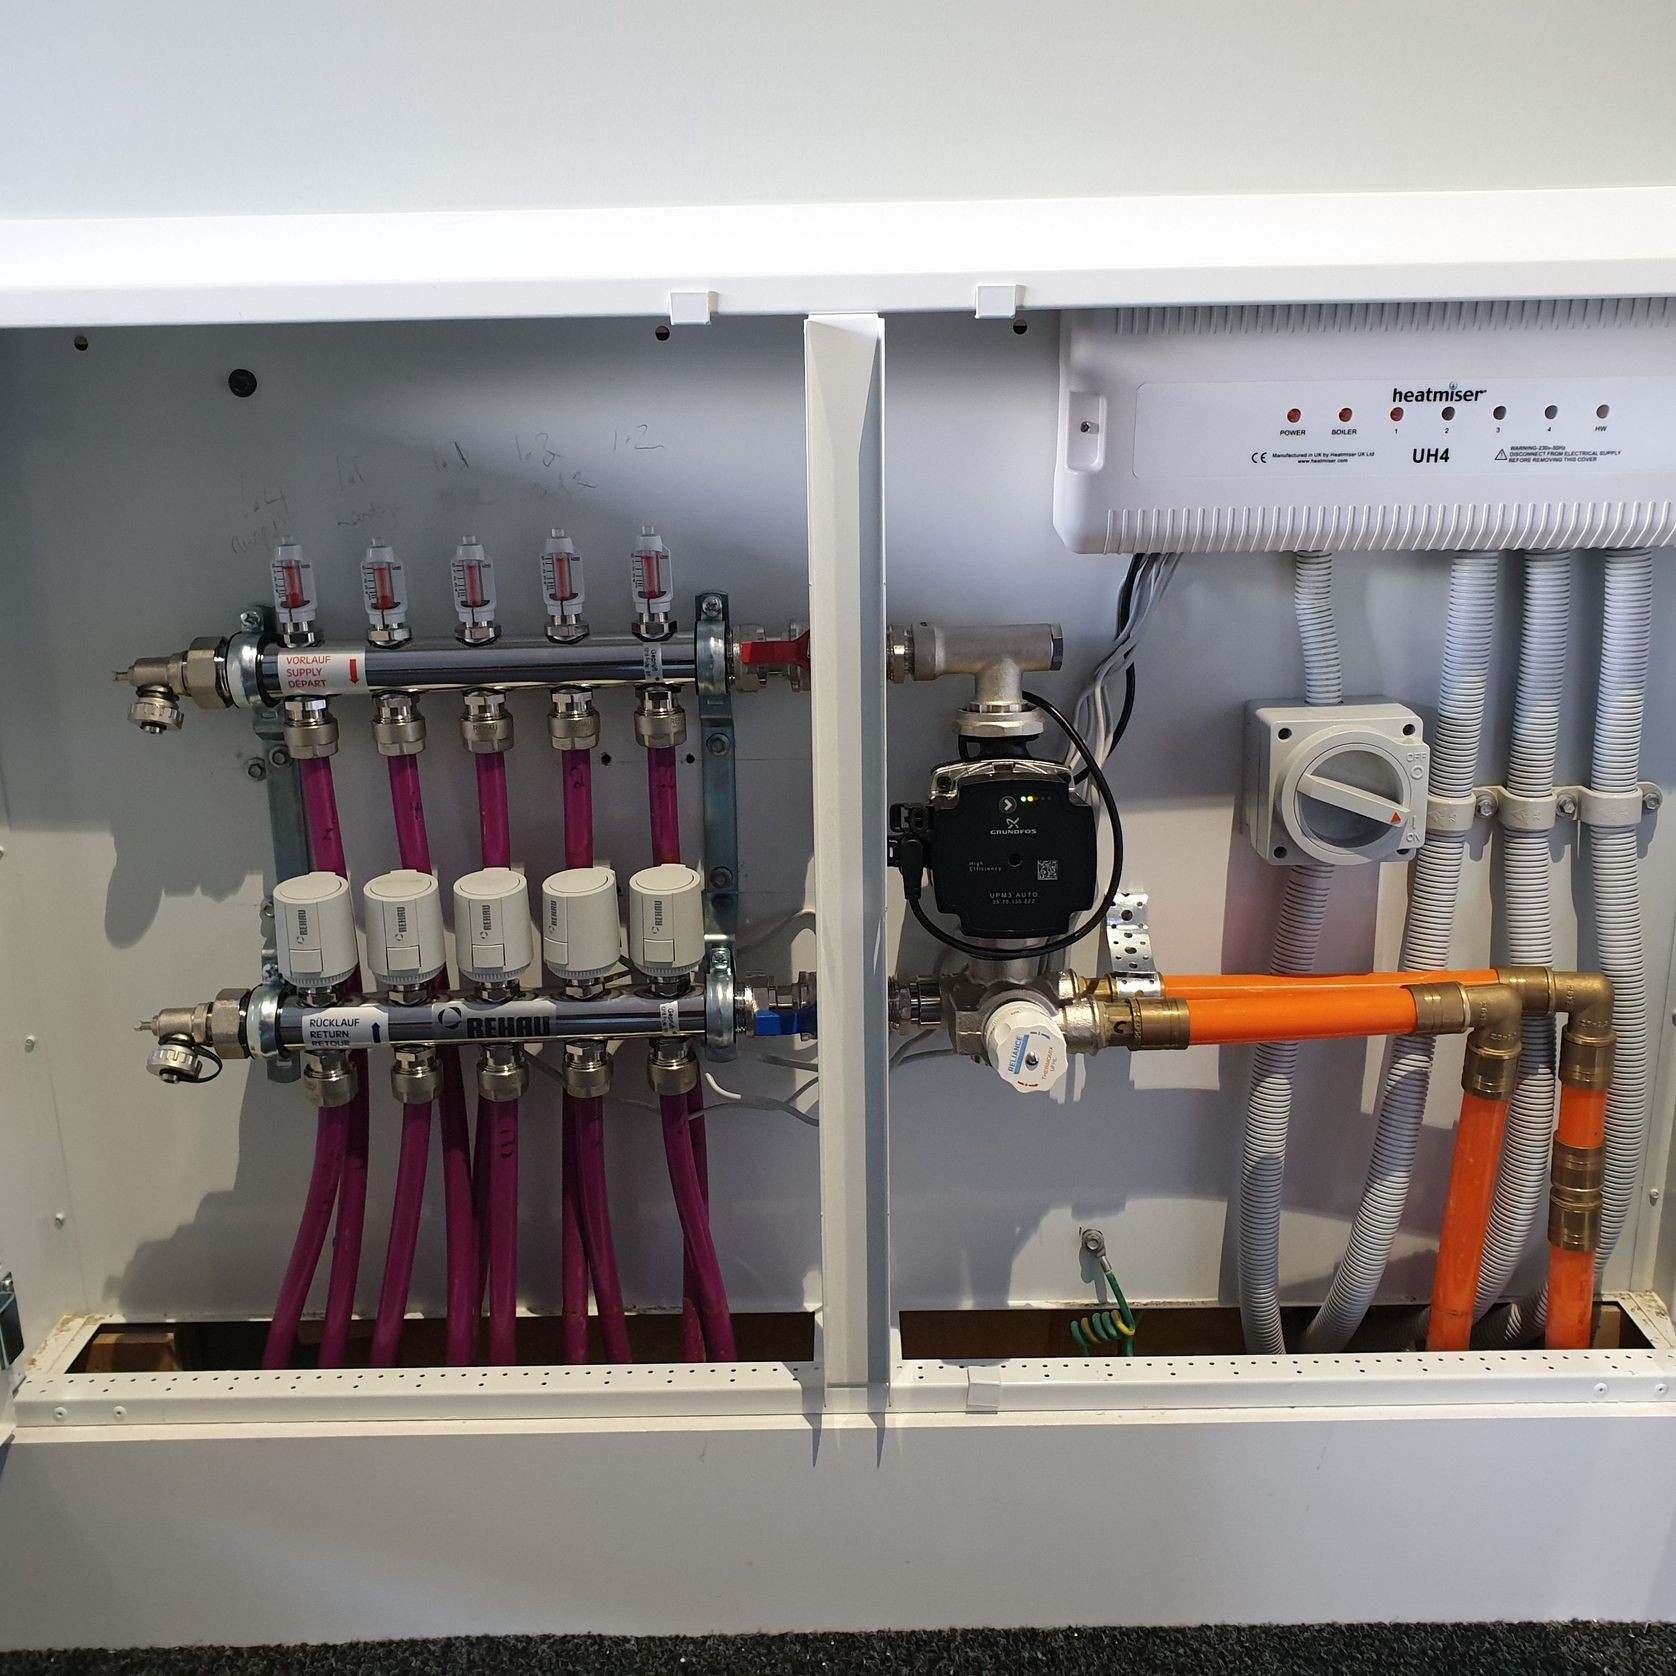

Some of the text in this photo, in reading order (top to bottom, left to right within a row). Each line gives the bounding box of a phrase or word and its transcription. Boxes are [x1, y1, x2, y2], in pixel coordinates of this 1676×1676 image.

[1393, 386, 1483, 402] heatmiser
[1331, 428, 1358, 436] BOILER
[1412, 448, 1450, 463] UH4
[286, 655, 331, 665] VORLAUF
[286, 668, 322, 677] SUPPLY
[288, 678, 327, 688] DÉPART
[1406, 752, 1427, 762] OFF
[1406, 832, 1421, 843] ON
[396, 906, 407, 933] REHAU
[481, 904, 492, 931] REHAU
[549, 900, 558, 927] REHAU
[654, 900, 663, 926] REHAU
[298, 909, 308, 936] REHAU
[309, 1017, 360, 1028] RÜCKLAUF
[466, 1016, 551, 1039] REHAU
[310, 1030, 350, 1039] RETURN
[1007, 1035, 1022, 1073] RELIANCE
